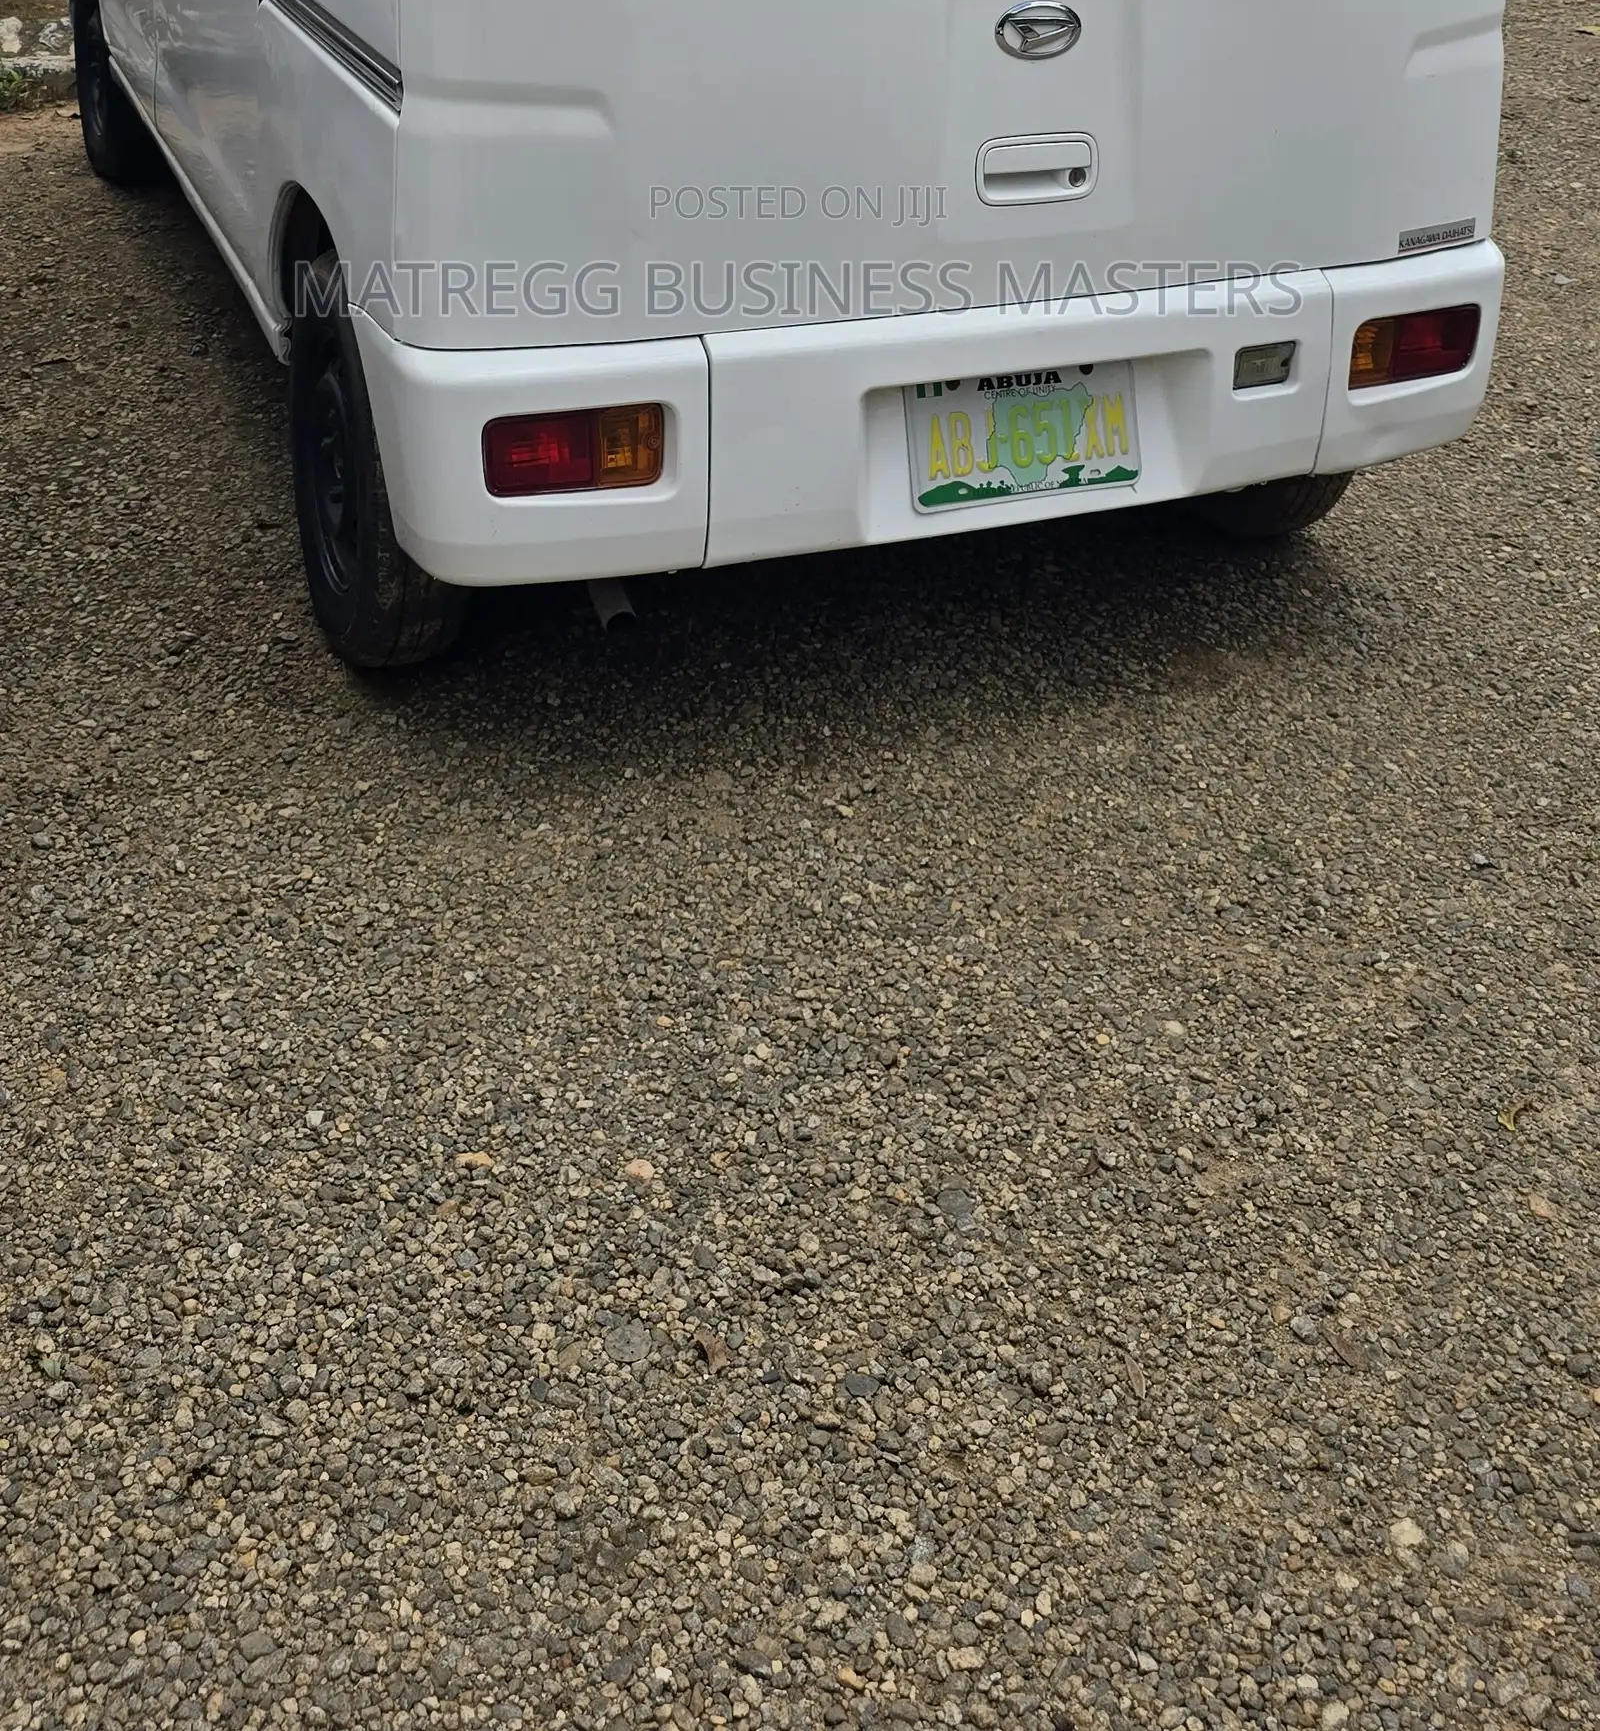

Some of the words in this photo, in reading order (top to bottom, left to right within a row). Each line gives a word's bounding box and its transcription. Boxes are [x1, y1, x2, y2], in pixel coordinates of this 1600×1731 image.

[1441, 225, 1475, 240] DAIHATSU
[977, 371, 1063, 391] ABUJA
[984, 388, 1016, 400] CENTRE
[1019, 386, 1031, 397] OF
[1032, 384, 1057, 395] UNITY
